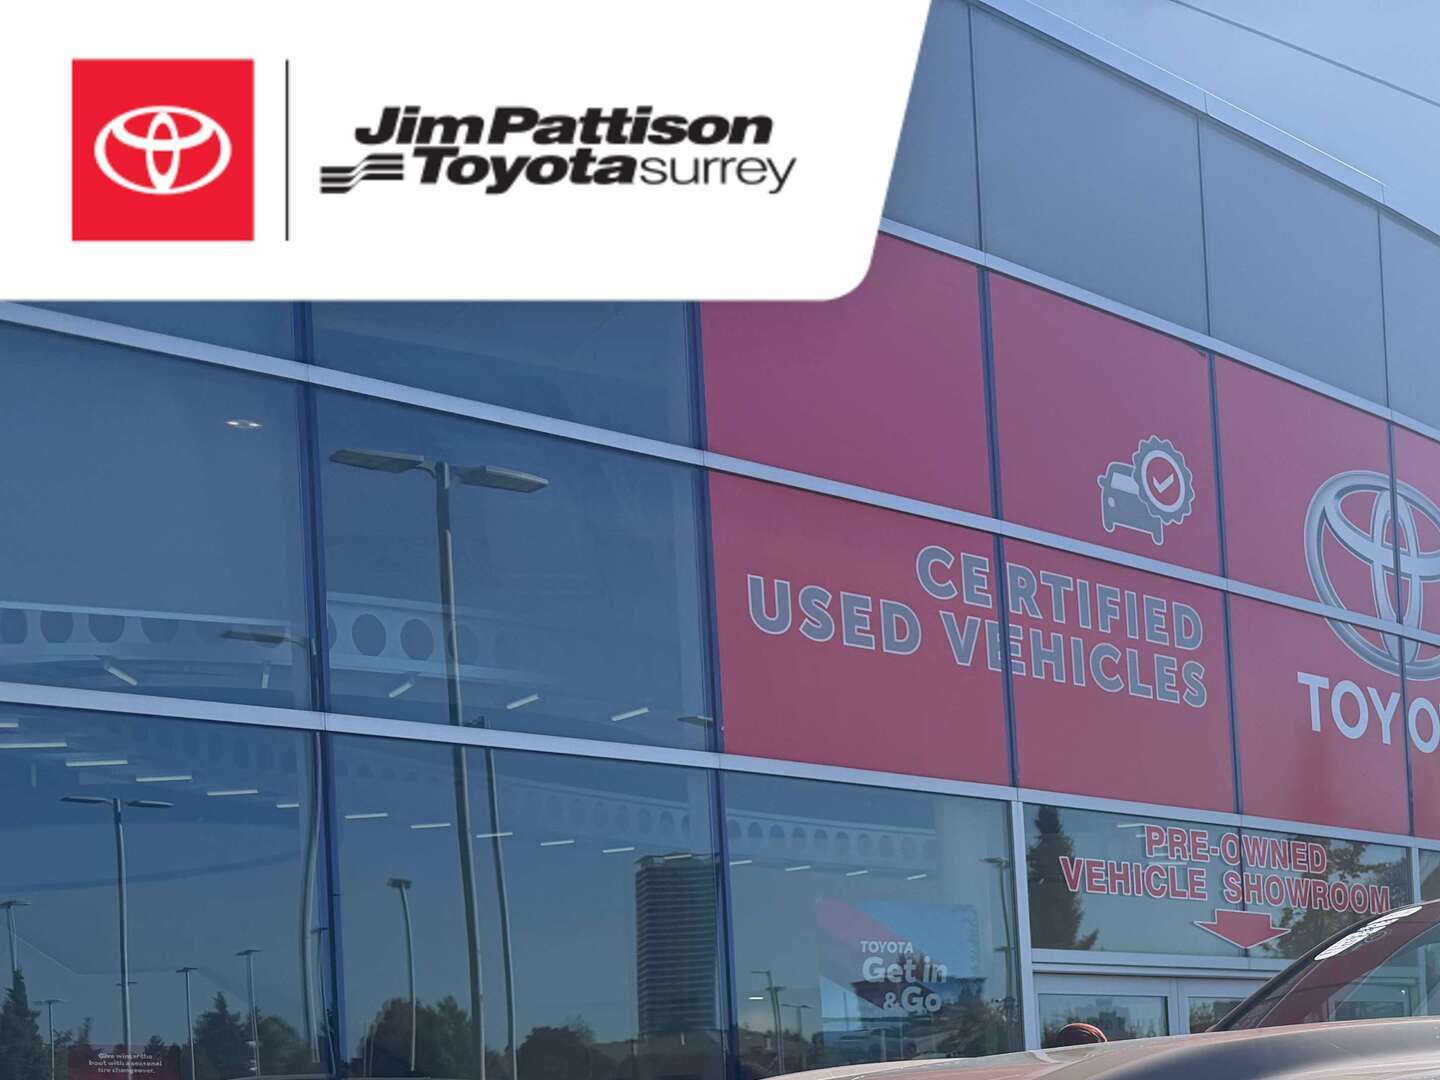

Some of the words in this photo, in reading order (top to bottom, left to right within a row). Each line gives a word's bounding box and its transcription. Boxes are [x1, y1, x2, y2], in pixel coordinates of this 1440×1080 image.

[915, 545, 1203, 651] CERTIFIED
[746, 574, 922, 656] USED
[940, 610, 1208, 707] VEHICLES
[1144, 823, 1328, 875] PRE-OWNED
[1058, 854, 1208, 902] VEHICLE
[1223, 871, 1391, 915] SHOWROOM
[860, 940, 914, 954] TOYOTA
[862, 956, 917, 984] Get
[923, 956, 948, 983] in
